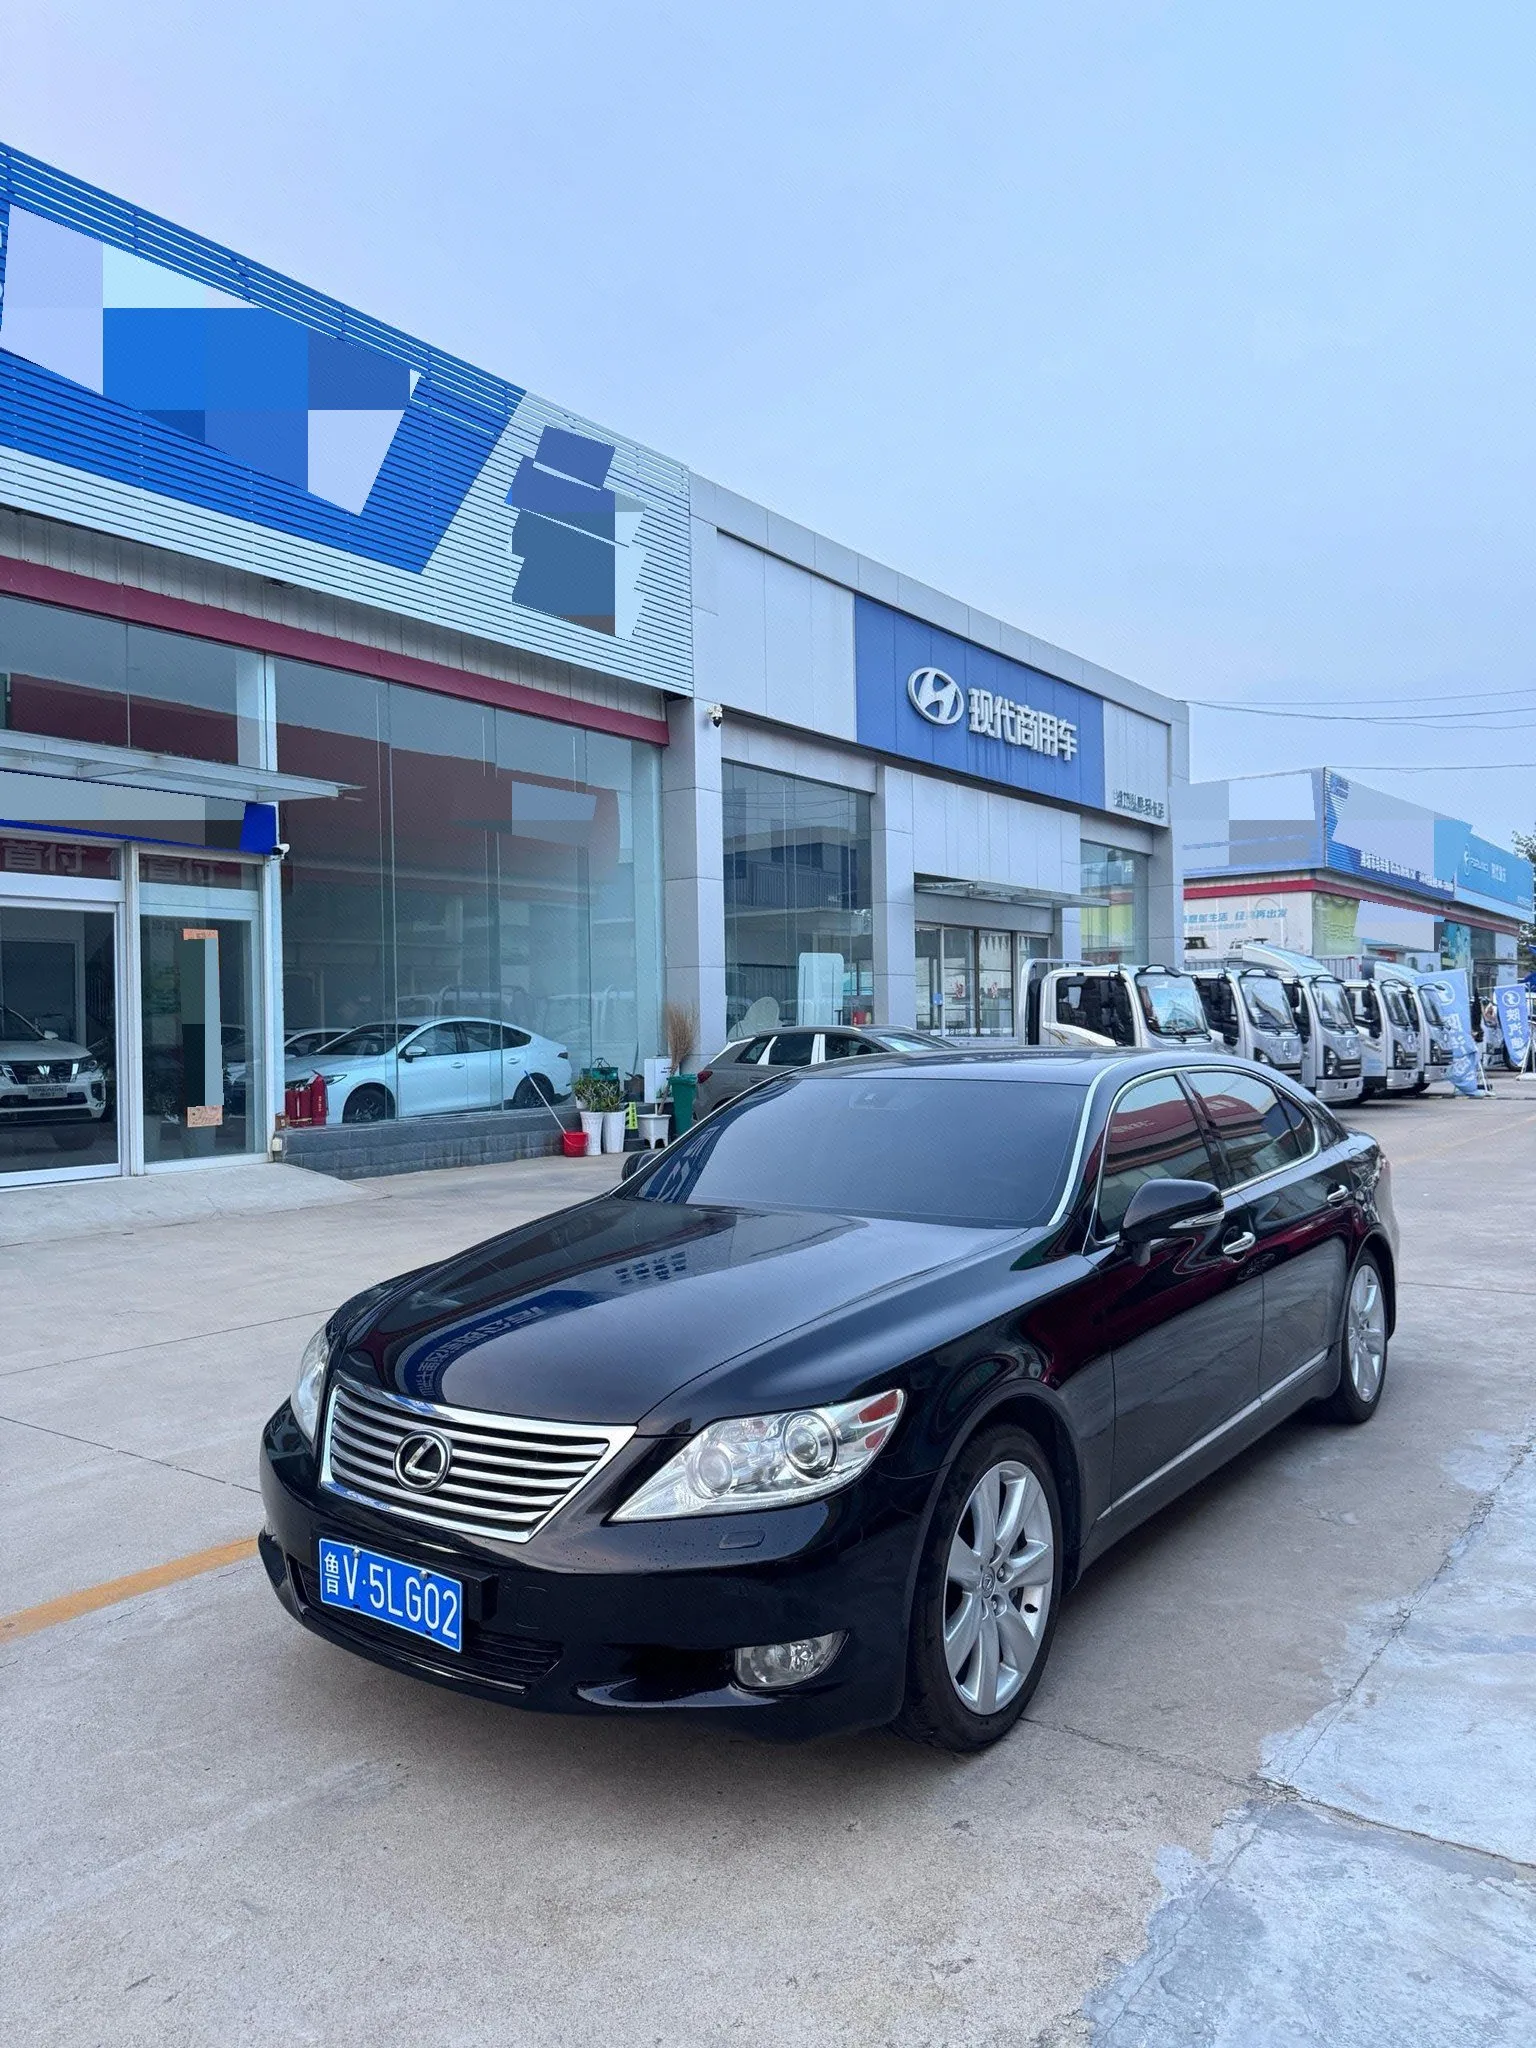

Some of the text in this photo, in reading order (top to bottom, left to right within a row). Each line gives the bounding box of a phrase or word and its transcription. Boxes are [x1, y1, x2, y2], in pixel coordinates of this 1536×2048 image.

[968, 688, 1078, 761] 现代商用车
